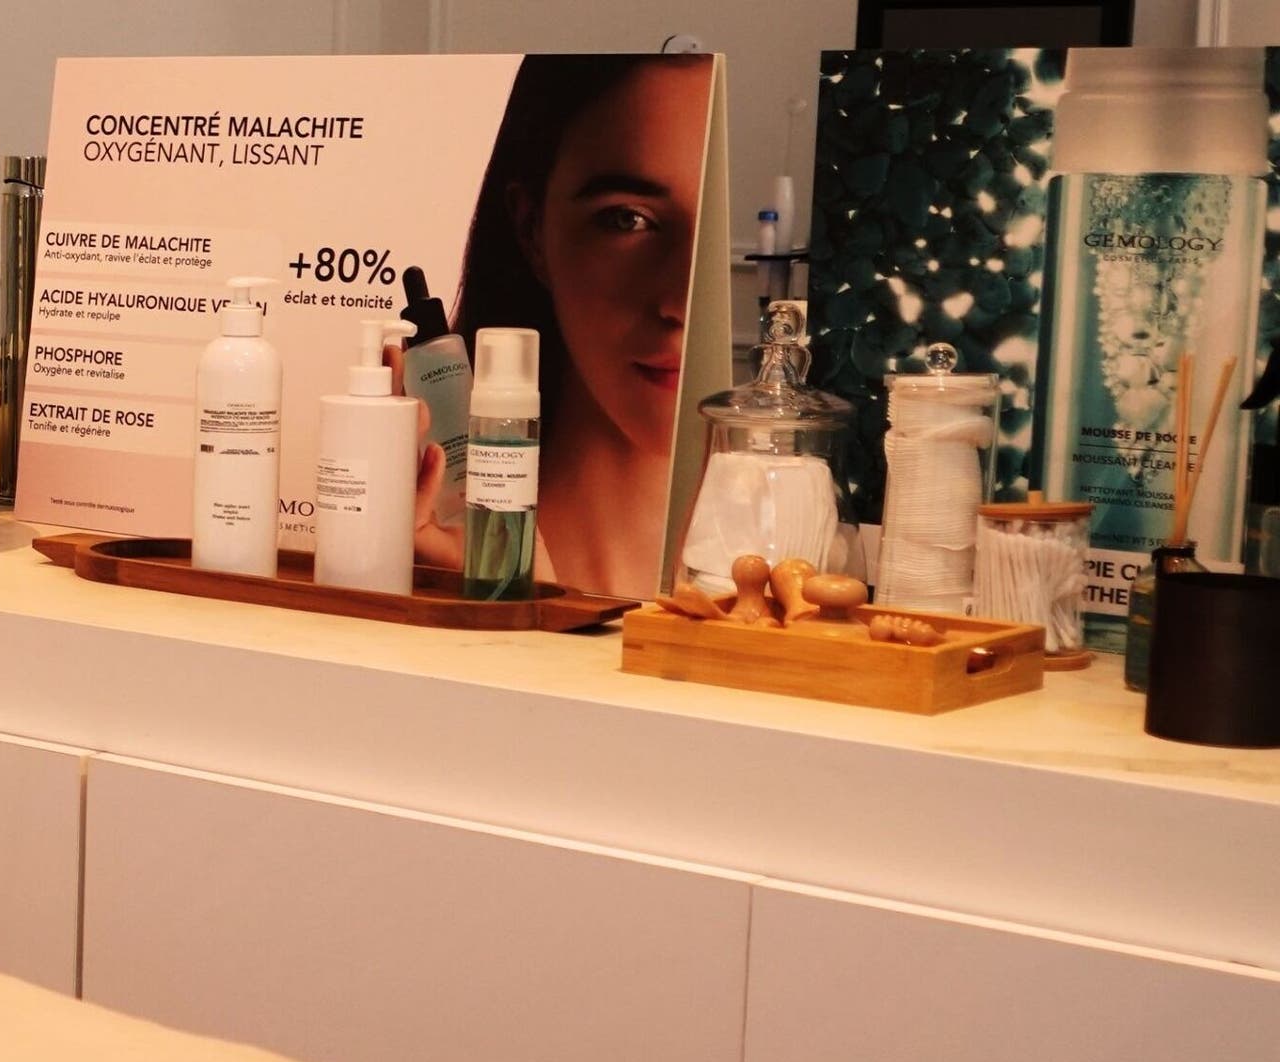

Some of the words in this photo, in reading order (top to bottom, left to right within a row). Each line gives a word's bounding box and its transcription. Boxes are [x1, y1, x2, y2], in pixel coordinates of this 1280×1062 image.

[85, 110, 221, 137] CONCENTRÉ
[227, 116, 365, 139] MALACHITE
[83, 137, 225, 168] OXYGÉNANT,
[232, 143, 325, 166] LISSANT
[45, 232, 97, 248] CUIVRE
[101, 234, 121, 249] DE
[124, 235, 212, 253] MALACHITE
[1084, 233, 1224, 251] GEMOLOGY
[44, 249, 103, 264] Anti-oxydant,
[104, 253, 131, 265] ravive
[162, 256, 173, 266] et
[175, 254, 213, 269] protège
[288, 247, 397, 286] +80%
[40, 289, 84, 305] ACIDE
[88, 292, 207, 313] HYALURONIQUE
[284, 290, 315, 306] éclat
[320, 294, 337, 307] et
[340, 293, 394, 310] tonicité
[39, 306, 73, 318] Hydrate
[75, 309, 86, 320] et
[87, 310, 121, 321] repulpe
[35, 346, 123, 366] PHOSPHORE
[33, 362, 73, 377] Oxygène
[74, 366, 84, 377] et
[86, 367, 125, 380] revitalise
[29, 402, 88, 421] EXTRAIT
[91, 408, 111, 424] DE
[115, 410, 155, 428] ROSE
[28, 420, 57, 433] Tonifie
[59, 424, 69, 433] et
[71, 424, 111, 438] régénère
[1081, 426, 1131, 440] MOUSSE
[1135, 431, 1151, 442] DE
[1155, 432, 1197, 445] ROCE
[1072, 453, 1137, 467] MOUSSANT
[1135, 501, 1176, 511] CLEANSE
